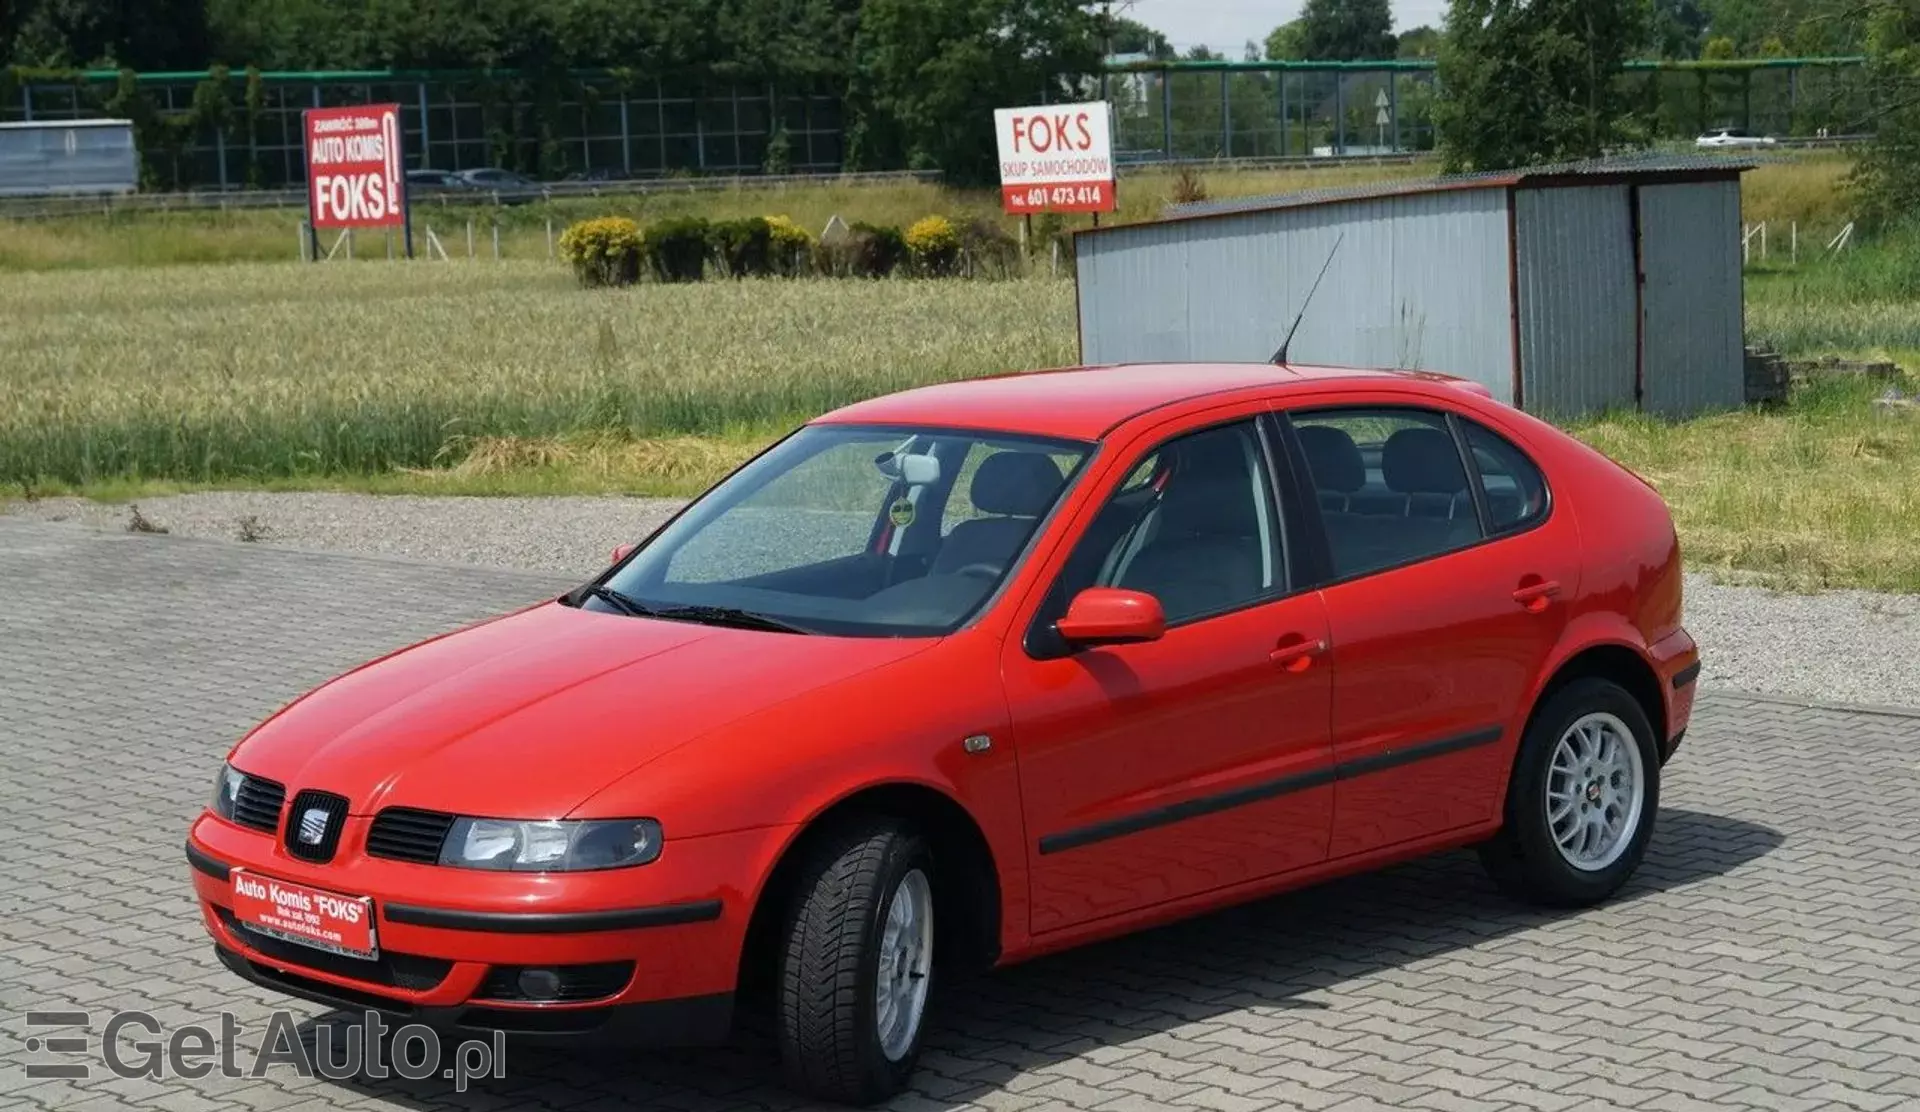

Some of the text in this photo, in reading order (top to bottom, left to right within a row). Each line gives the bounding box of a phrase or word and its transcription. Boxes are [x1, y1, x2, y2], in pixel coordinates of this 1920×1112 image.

[1012, 113, 1091, 153] FOKS
[312, 134, 384, 164] AUTO KOMIS
[1003, 161, 1028, 177] SKUP
[316, 173, 385, 220] FOKS
[1027, 188, 1048, 206] 601
[1052, 187, 1075, 204] 473
[1077, 186, 1101, 203] 414
[235, 875, 363, 923] Auto Komis "FOKS"
[259, 913, 342, 942] www.autofoks.com
